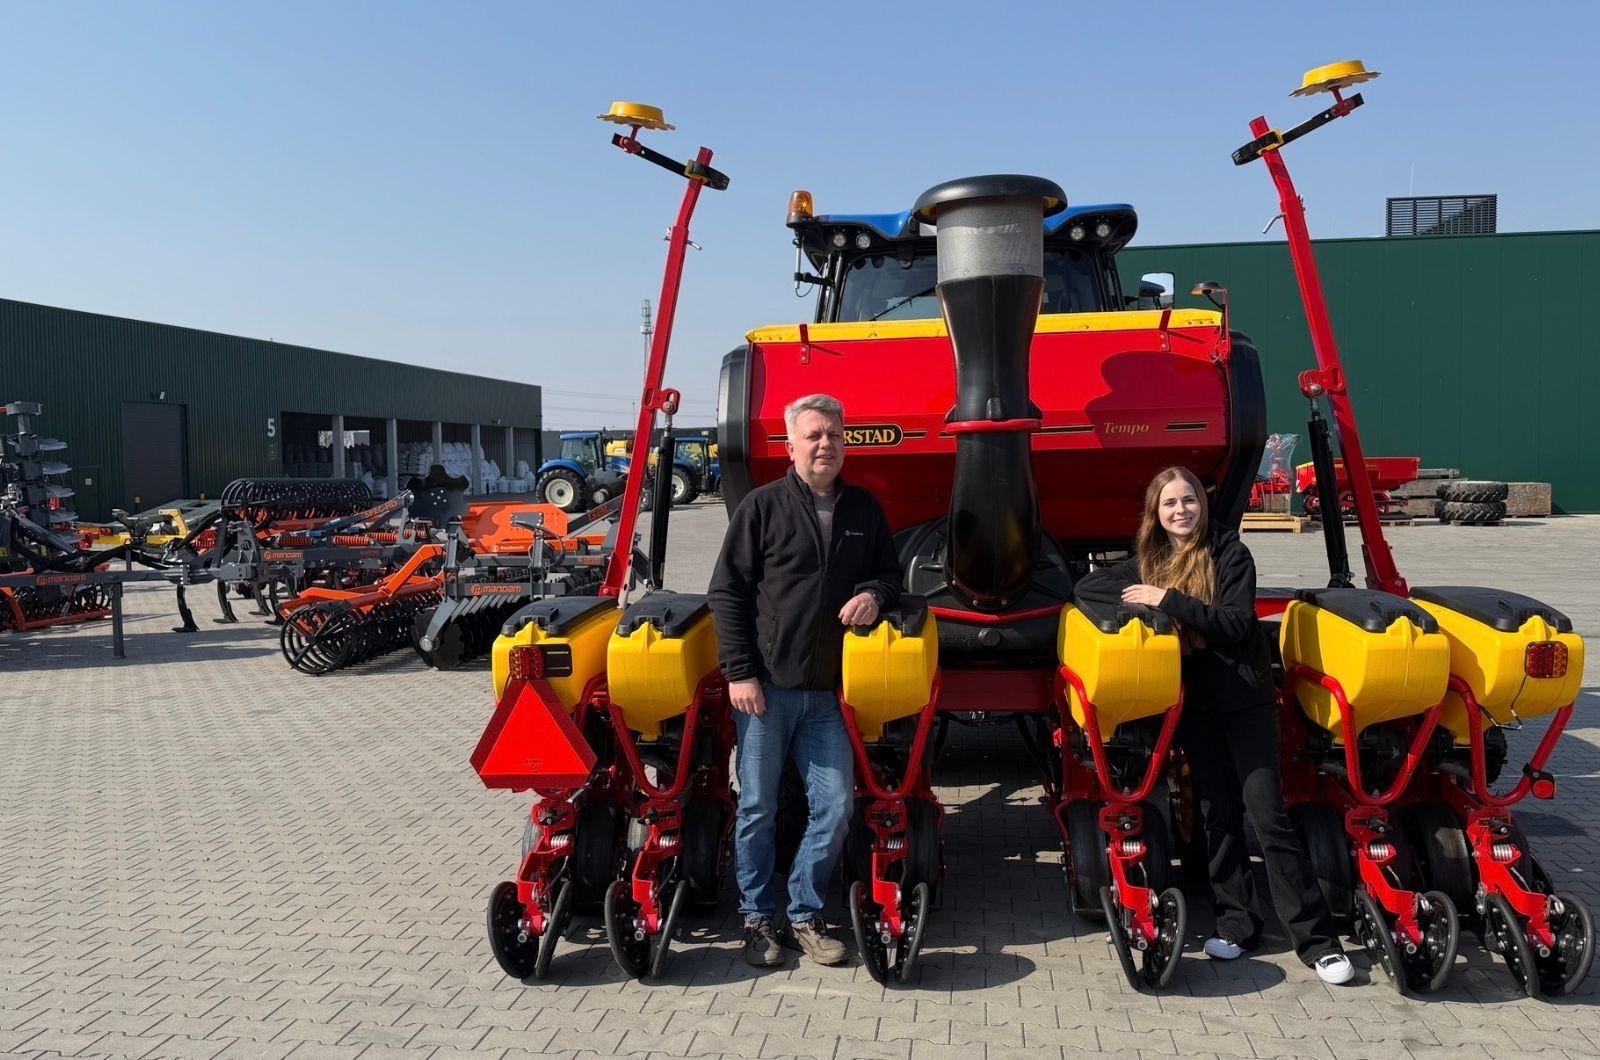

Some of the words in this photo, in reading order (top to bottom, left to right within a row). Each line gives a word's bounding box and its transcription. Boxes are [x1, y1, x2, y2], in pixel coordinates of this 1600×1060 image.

[267, 418, 276, 437] 5
[1104, 422, 1150, 436] Tempo
[843, 428, 896, 444] RSTAD
